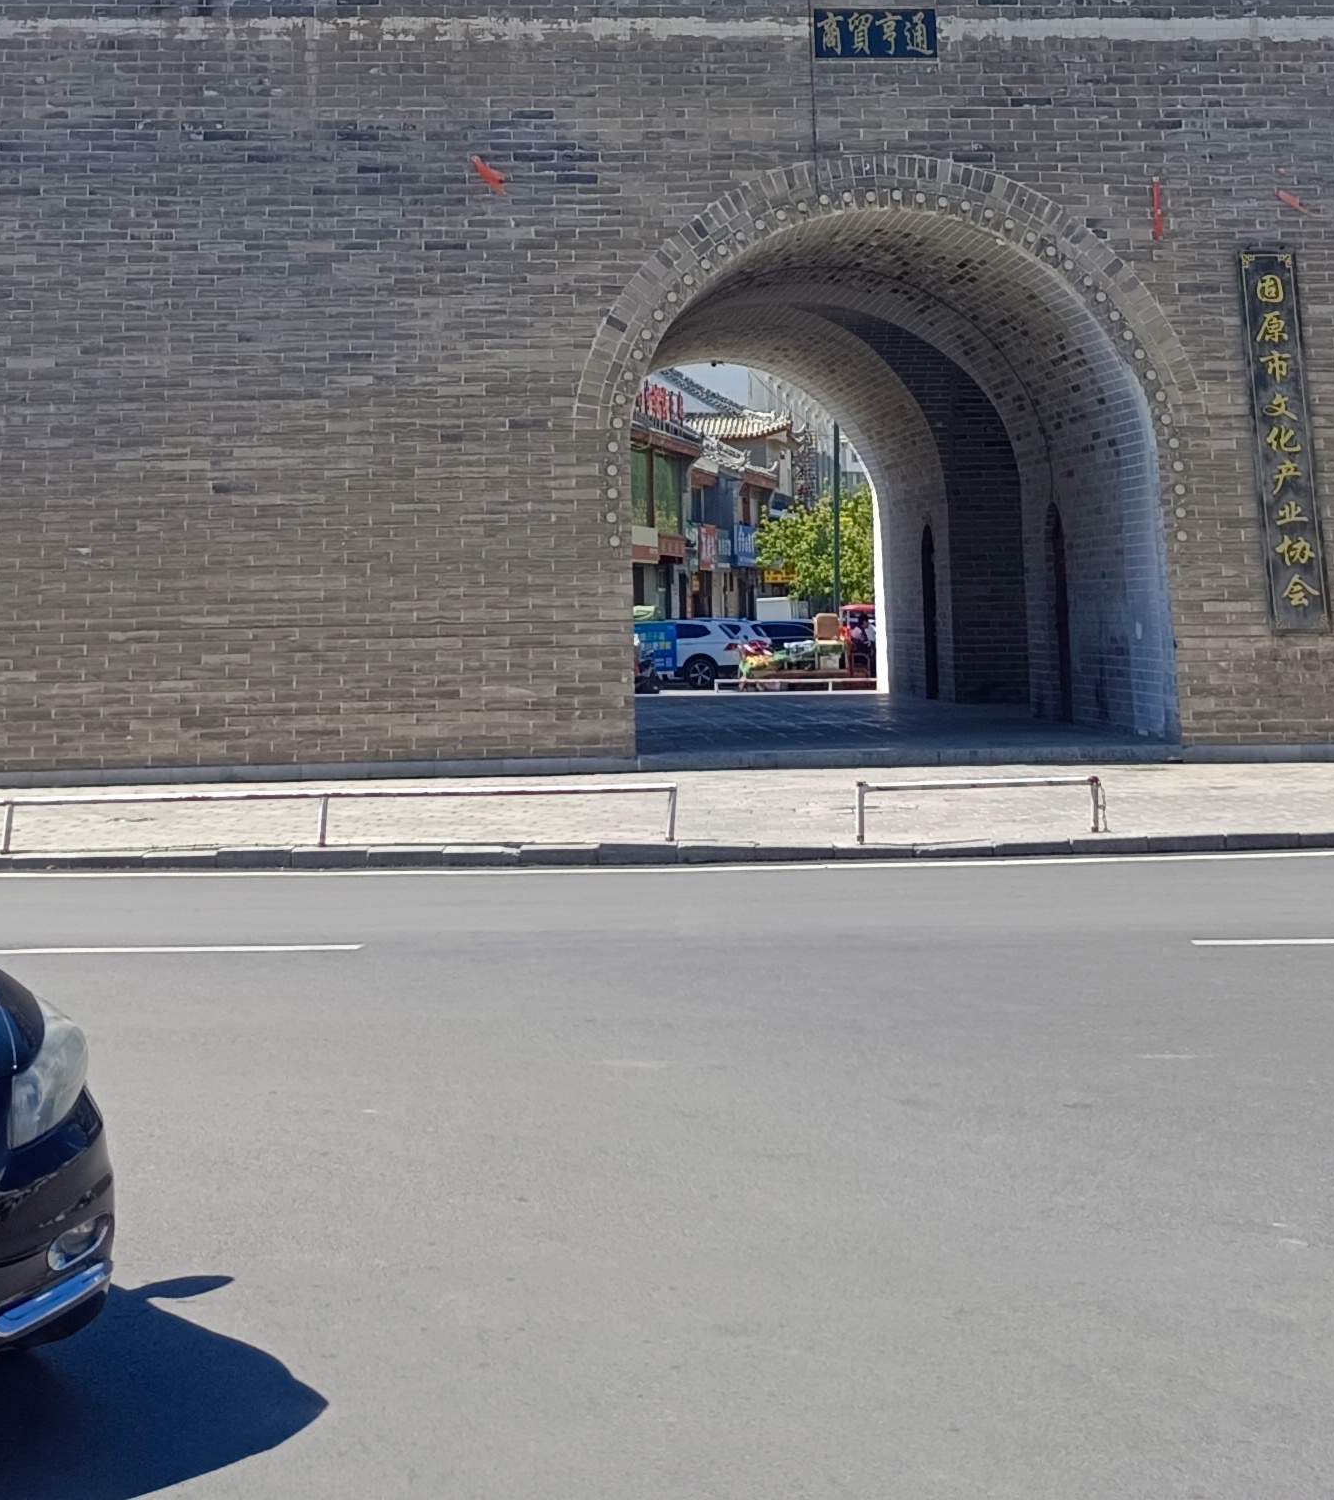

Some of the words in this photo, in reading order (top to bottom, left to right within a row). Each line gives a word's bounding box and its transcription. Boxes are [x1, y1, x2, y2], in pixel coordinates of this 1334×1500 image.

[1255, 274, 1321, 607] 固原市文化产业协会
